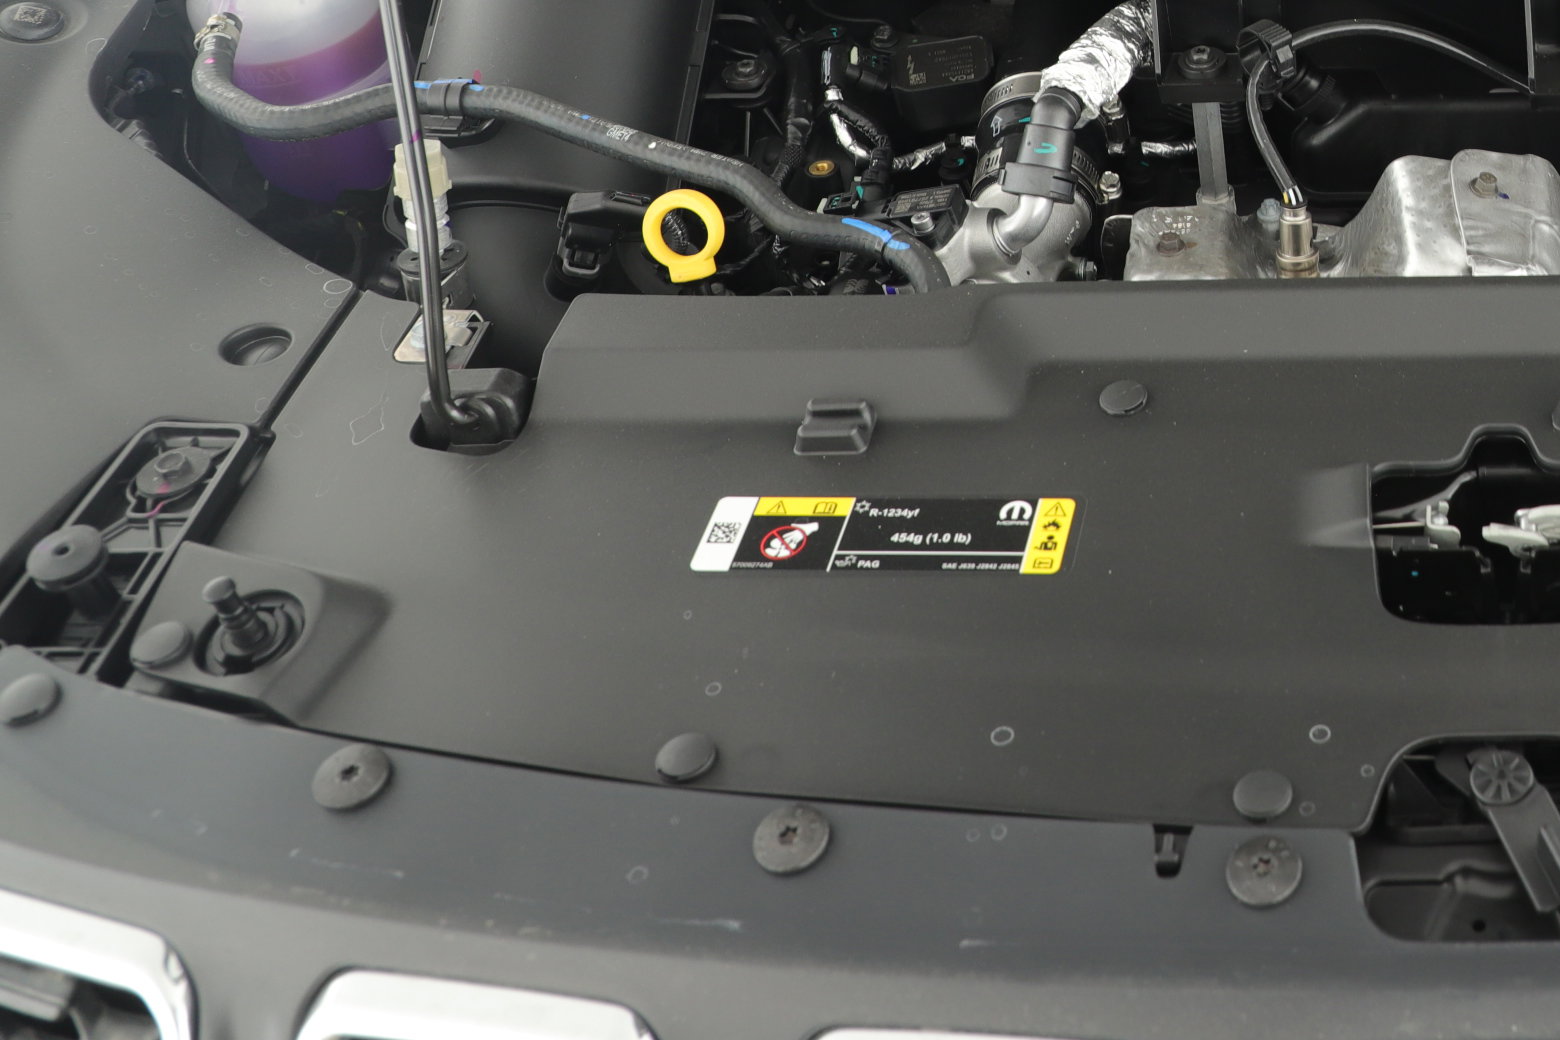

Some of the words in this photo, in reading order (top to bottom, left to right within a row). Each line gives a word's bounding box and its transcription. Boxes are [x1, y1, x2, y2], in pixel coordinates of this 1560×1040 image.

[869, 507, 921, 519] R-1234yf
[890, 533, 923, 545] 454g
[926, 533, 951, 545] (1.0
[953, 533, 972, 545] lb)
[857, 559, 880, 569] PAG
